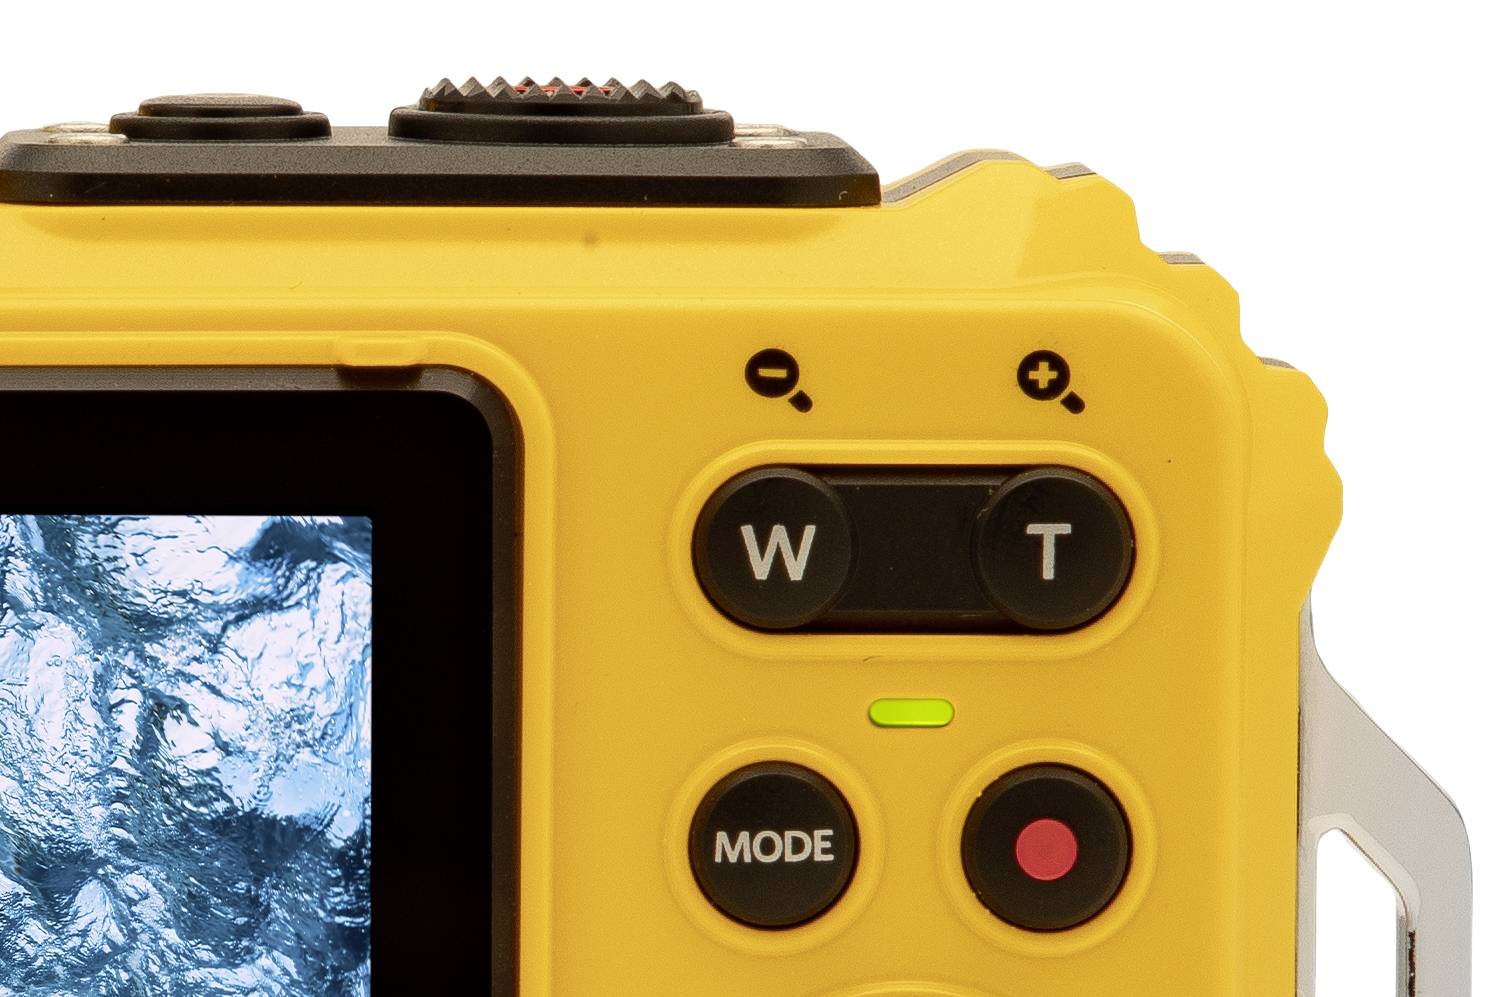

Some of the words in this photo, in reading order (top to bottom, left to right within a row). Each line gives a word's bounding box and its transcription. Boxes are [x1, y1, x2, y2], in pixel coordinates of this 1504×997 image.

[740, 523, 817, 582] W
[1025, 523, 1072, 581] T
[714, 828, 835, 864] MODE
